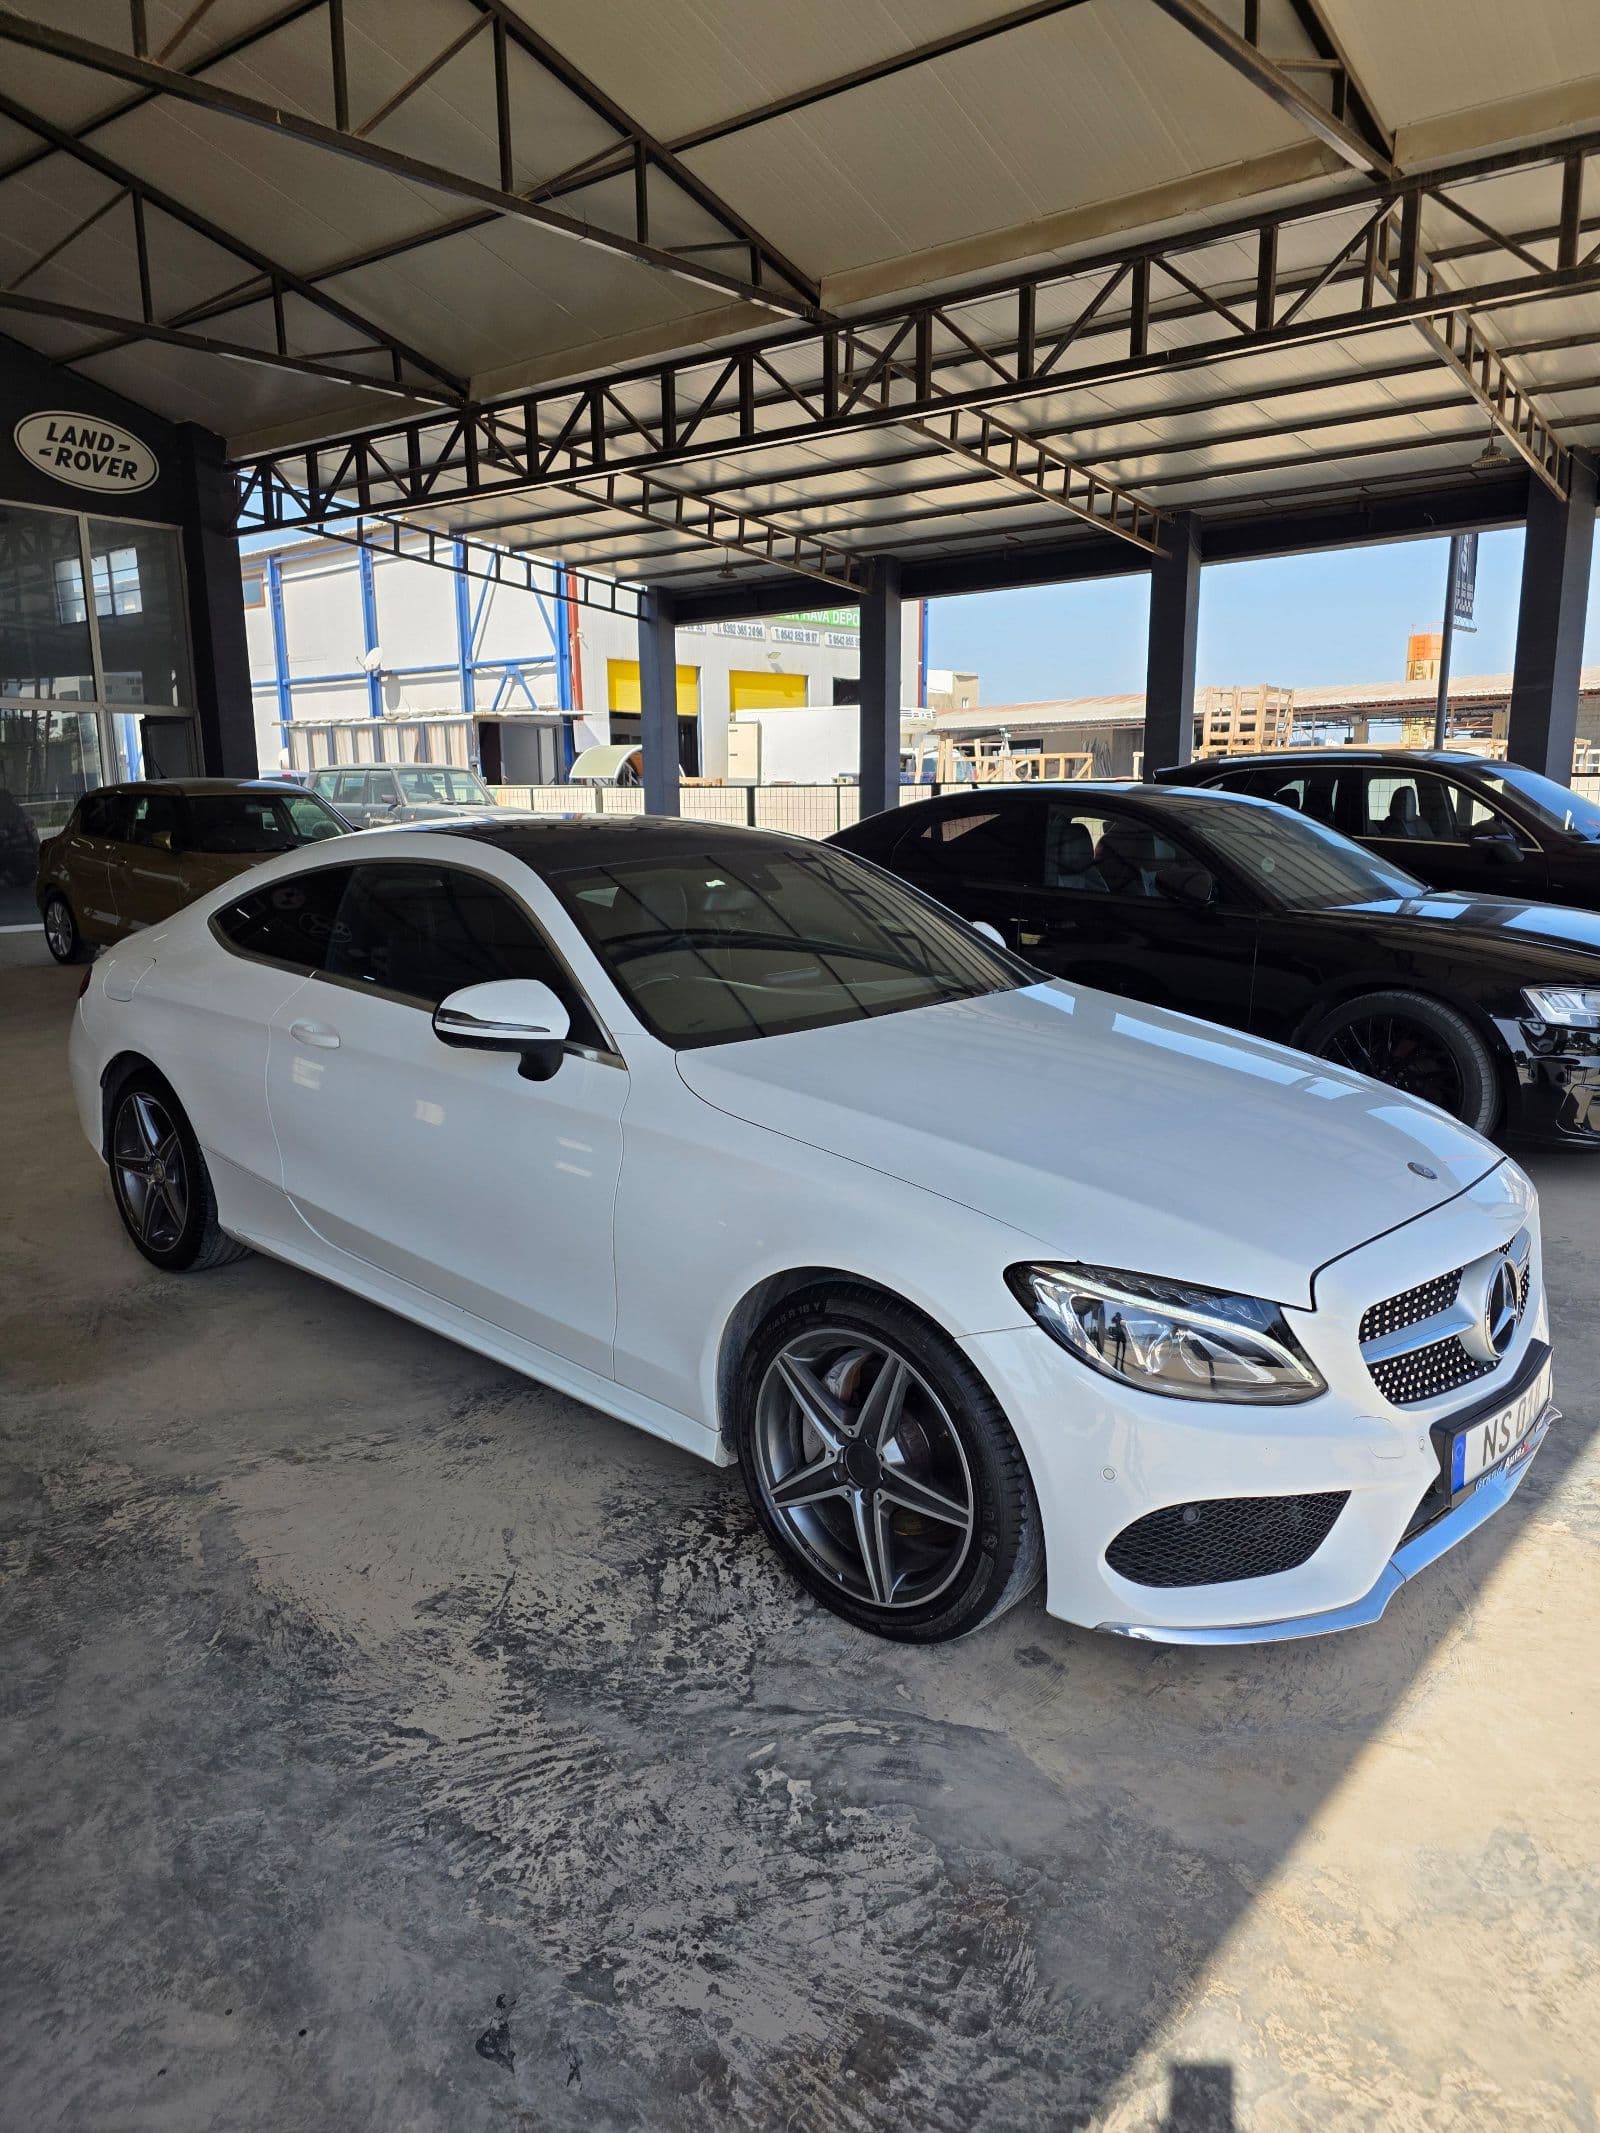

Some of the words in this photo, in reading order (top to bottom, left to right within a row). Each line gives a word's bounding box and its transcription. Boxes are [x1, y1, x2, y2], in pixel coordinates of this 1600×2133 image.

[46, 421, 115, 453] LAND
[54, 446, 138, 481] ROVER
[1483, 1410, 1512, 1467] NS
